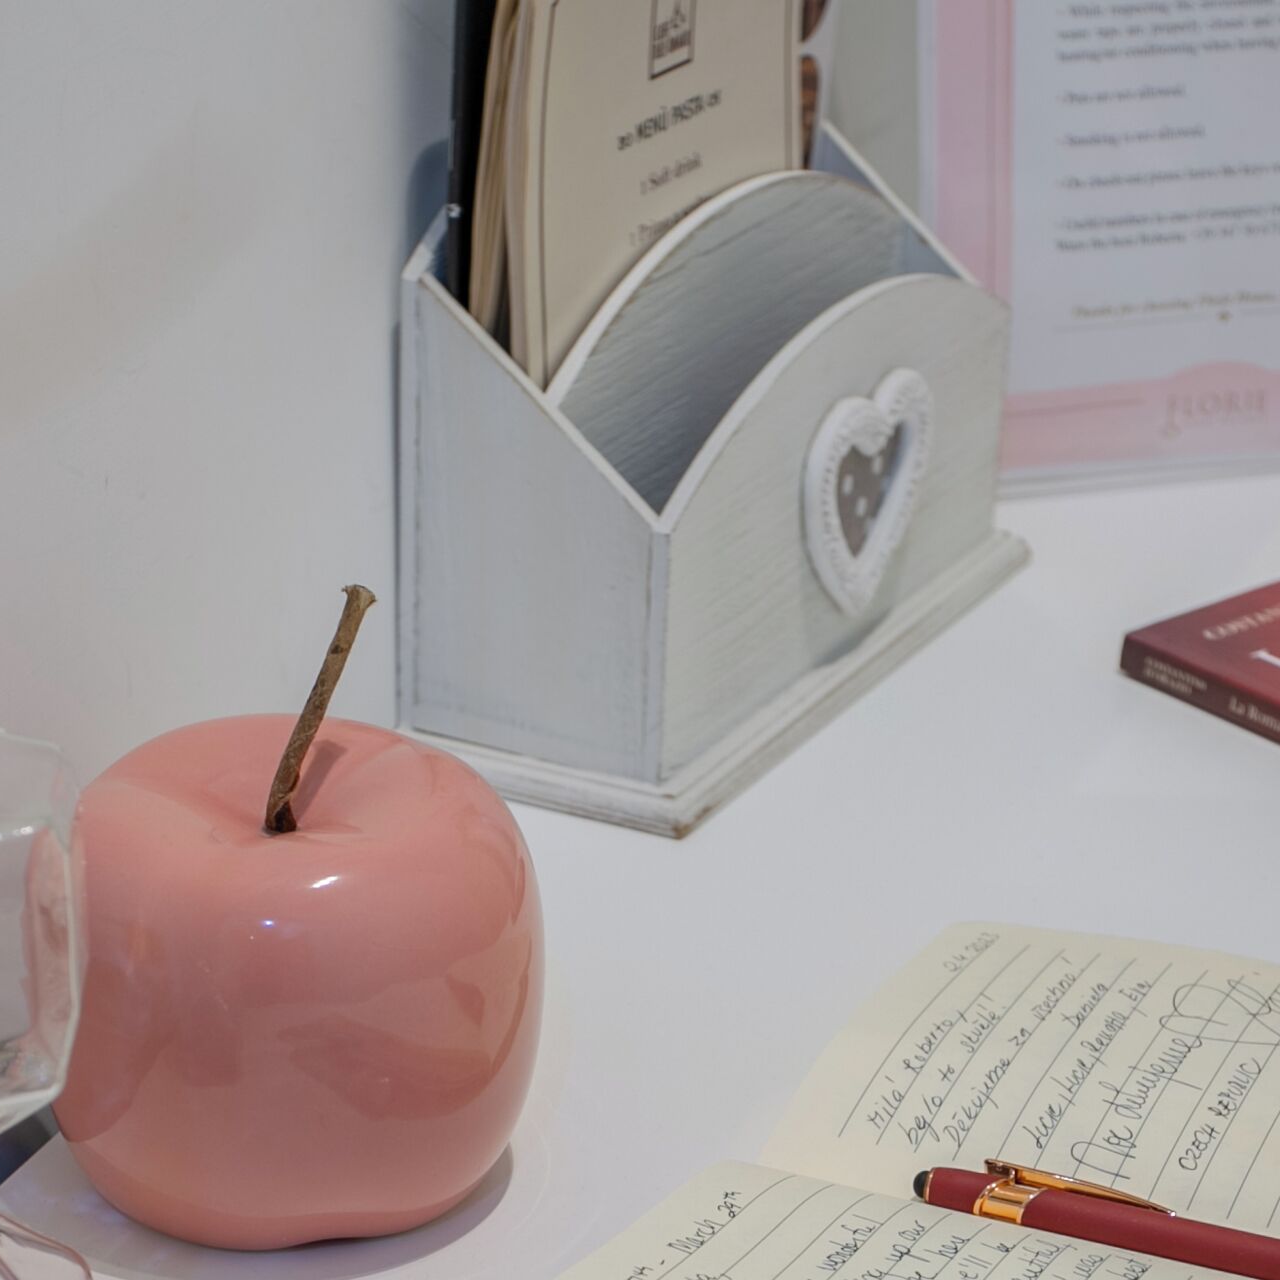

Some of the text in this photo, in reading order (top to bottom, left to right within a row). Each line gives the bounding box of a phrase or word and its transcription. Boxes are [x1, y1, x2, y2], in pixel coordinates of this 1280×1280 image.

[1229, 694, 1246, 714] La
[1179, 1056, 1263, 1172] CZECH REPUBLIC
[666, 1218, 725, 1256] March
[816, 1213, 885, 1273] wonderful
[897, 1219, 926, 1242] our
[885, 1242, 931, 1264] up
[1073, 1253, 1104, 1280] was
